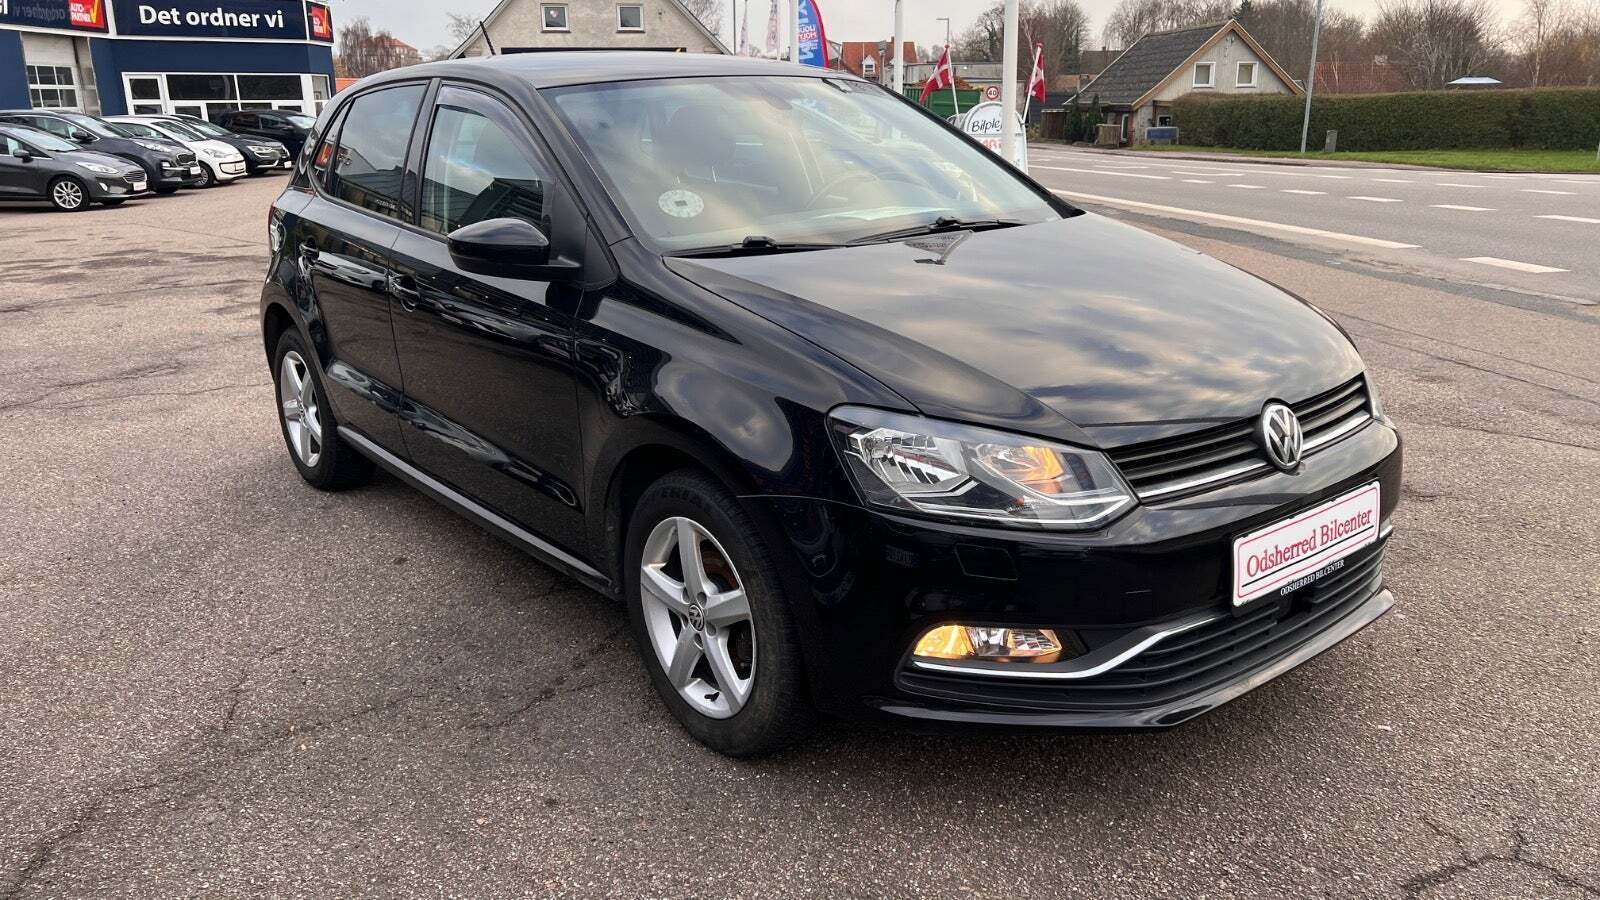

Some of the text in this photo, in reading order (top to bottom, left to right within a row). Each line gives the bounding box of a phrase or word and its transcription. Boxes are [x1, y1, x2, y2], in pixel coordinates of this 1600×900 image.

[138, 5, 284, 28] Det ordner vi
[988, 89, 997, 97] 40
[971, 118, 1003, 134] Bilple
[1246, 509, 1372, 577] Odsherred Bilcenter
[1280, 560, 1345, 596] ODSHERRED BILCENTER
